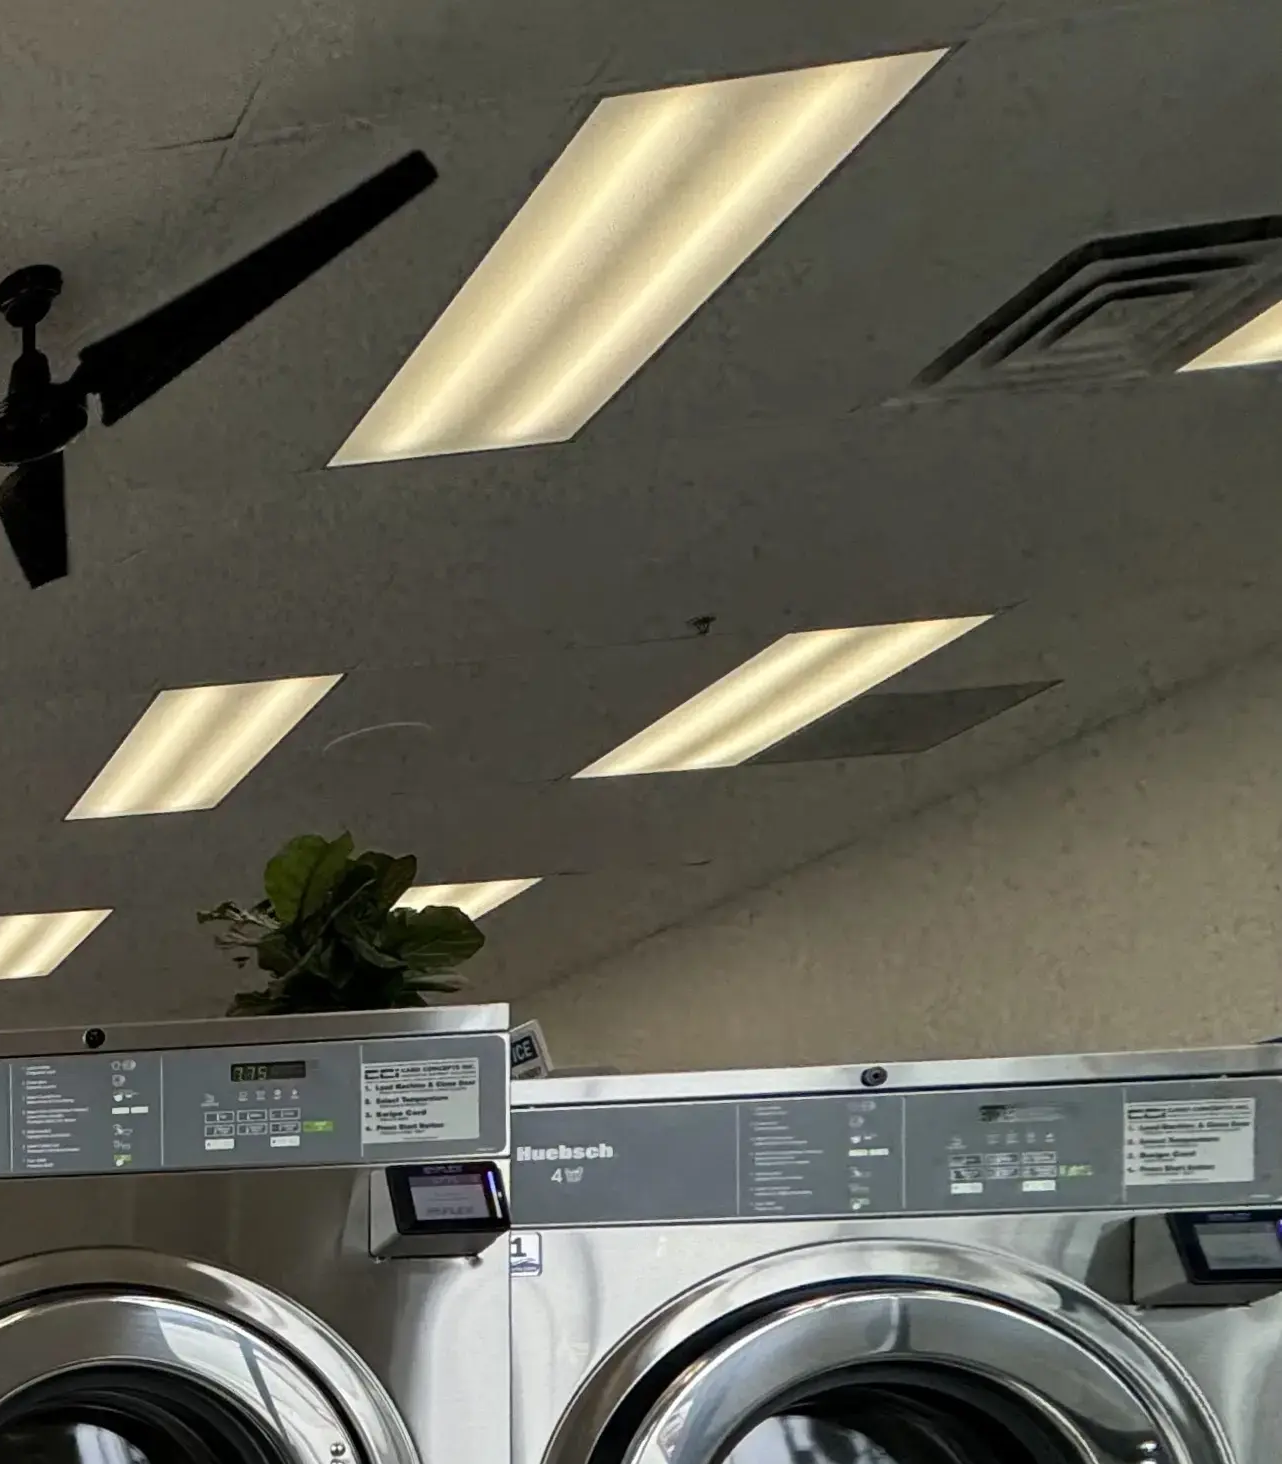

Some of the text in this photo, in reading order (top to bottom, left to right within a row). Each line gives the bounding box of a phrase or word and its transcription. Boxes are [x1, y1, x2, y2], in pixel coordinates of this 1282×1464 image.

[516, 1143, 614, 1161] Huebsch
[550, 1168, 563, 1183] 4
[511, 1237, 527, 1257] 1
